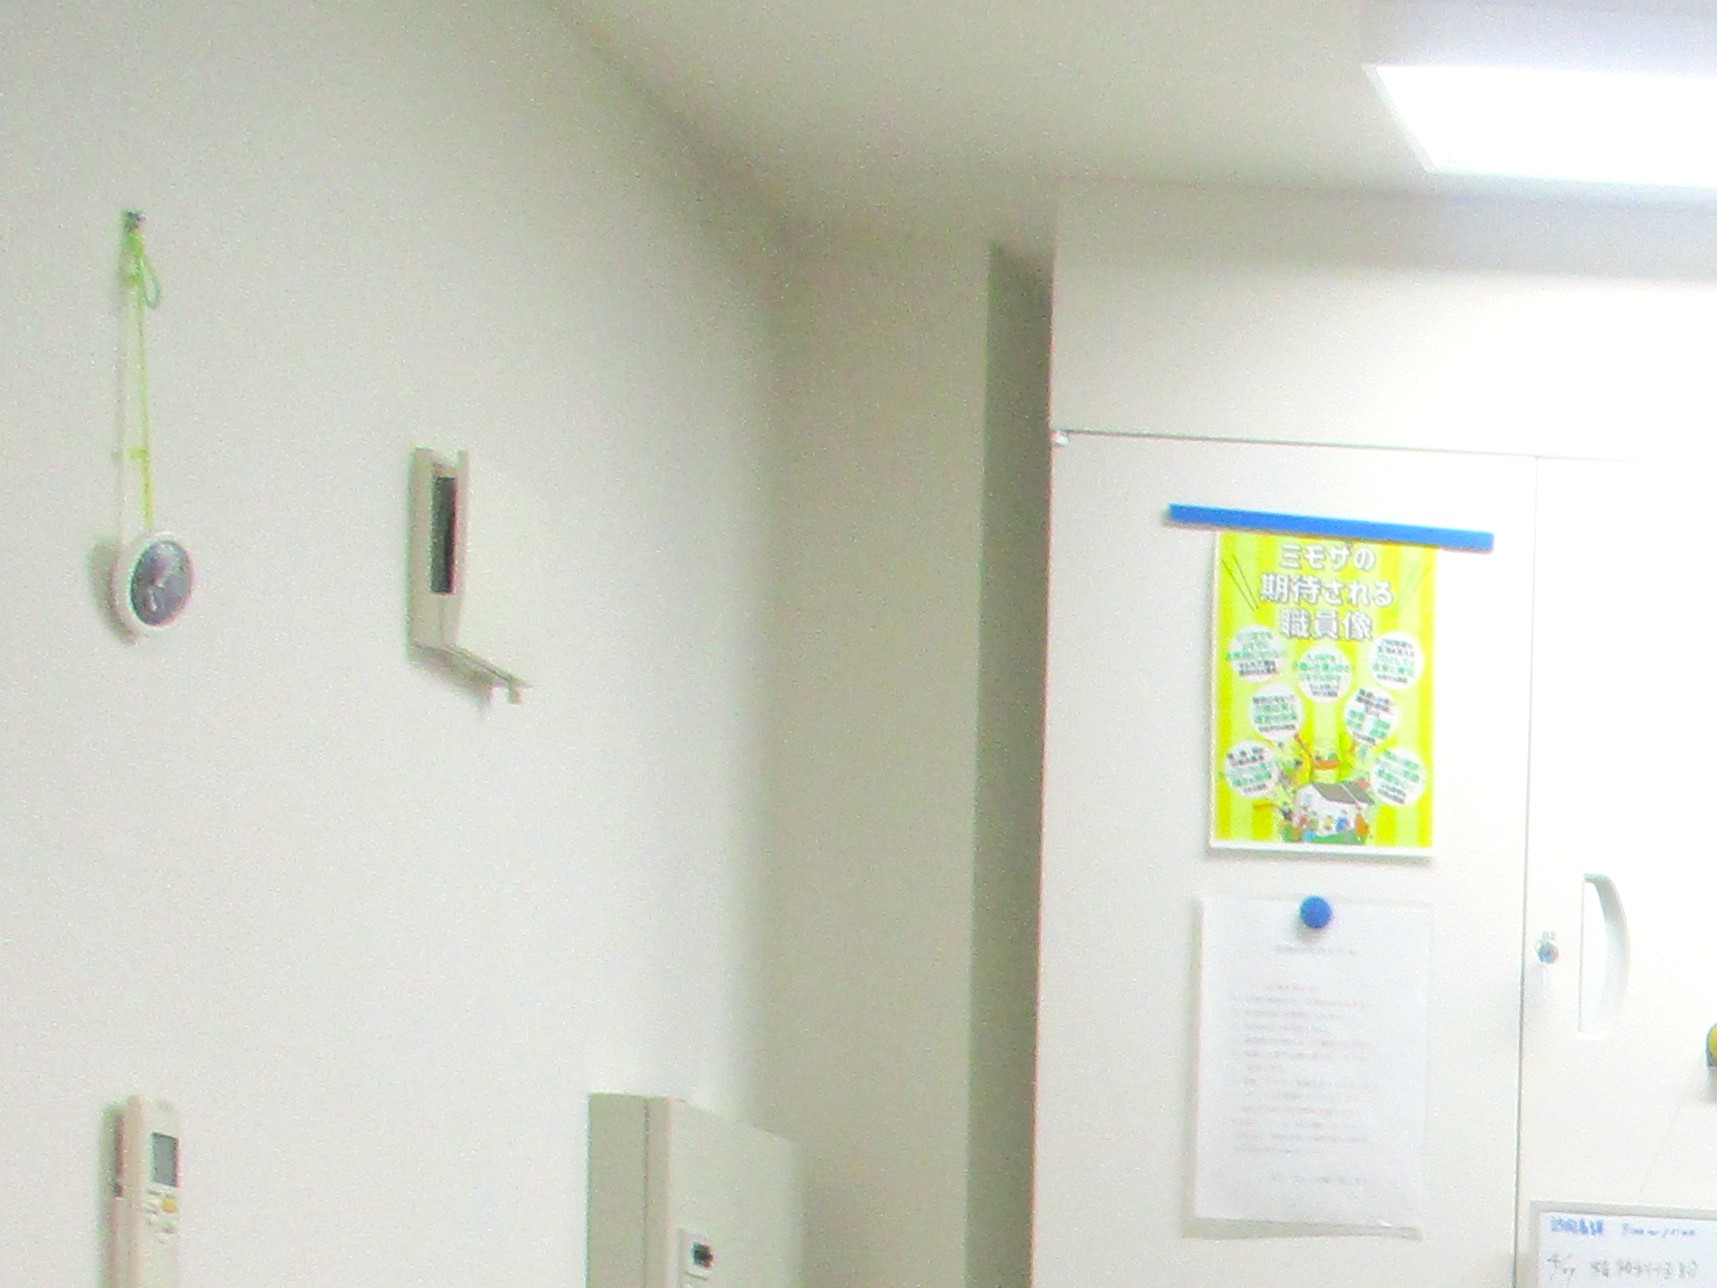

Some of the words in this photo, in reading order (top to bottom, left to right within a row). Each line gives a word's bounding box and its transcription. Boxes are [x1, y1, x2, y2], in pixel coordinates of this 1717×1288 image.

[1279, 541, 1377, 570] ミモザの
[1260, 573, 1394, 606] 期待される
[1279, 610, 1374, 640] 職員像
